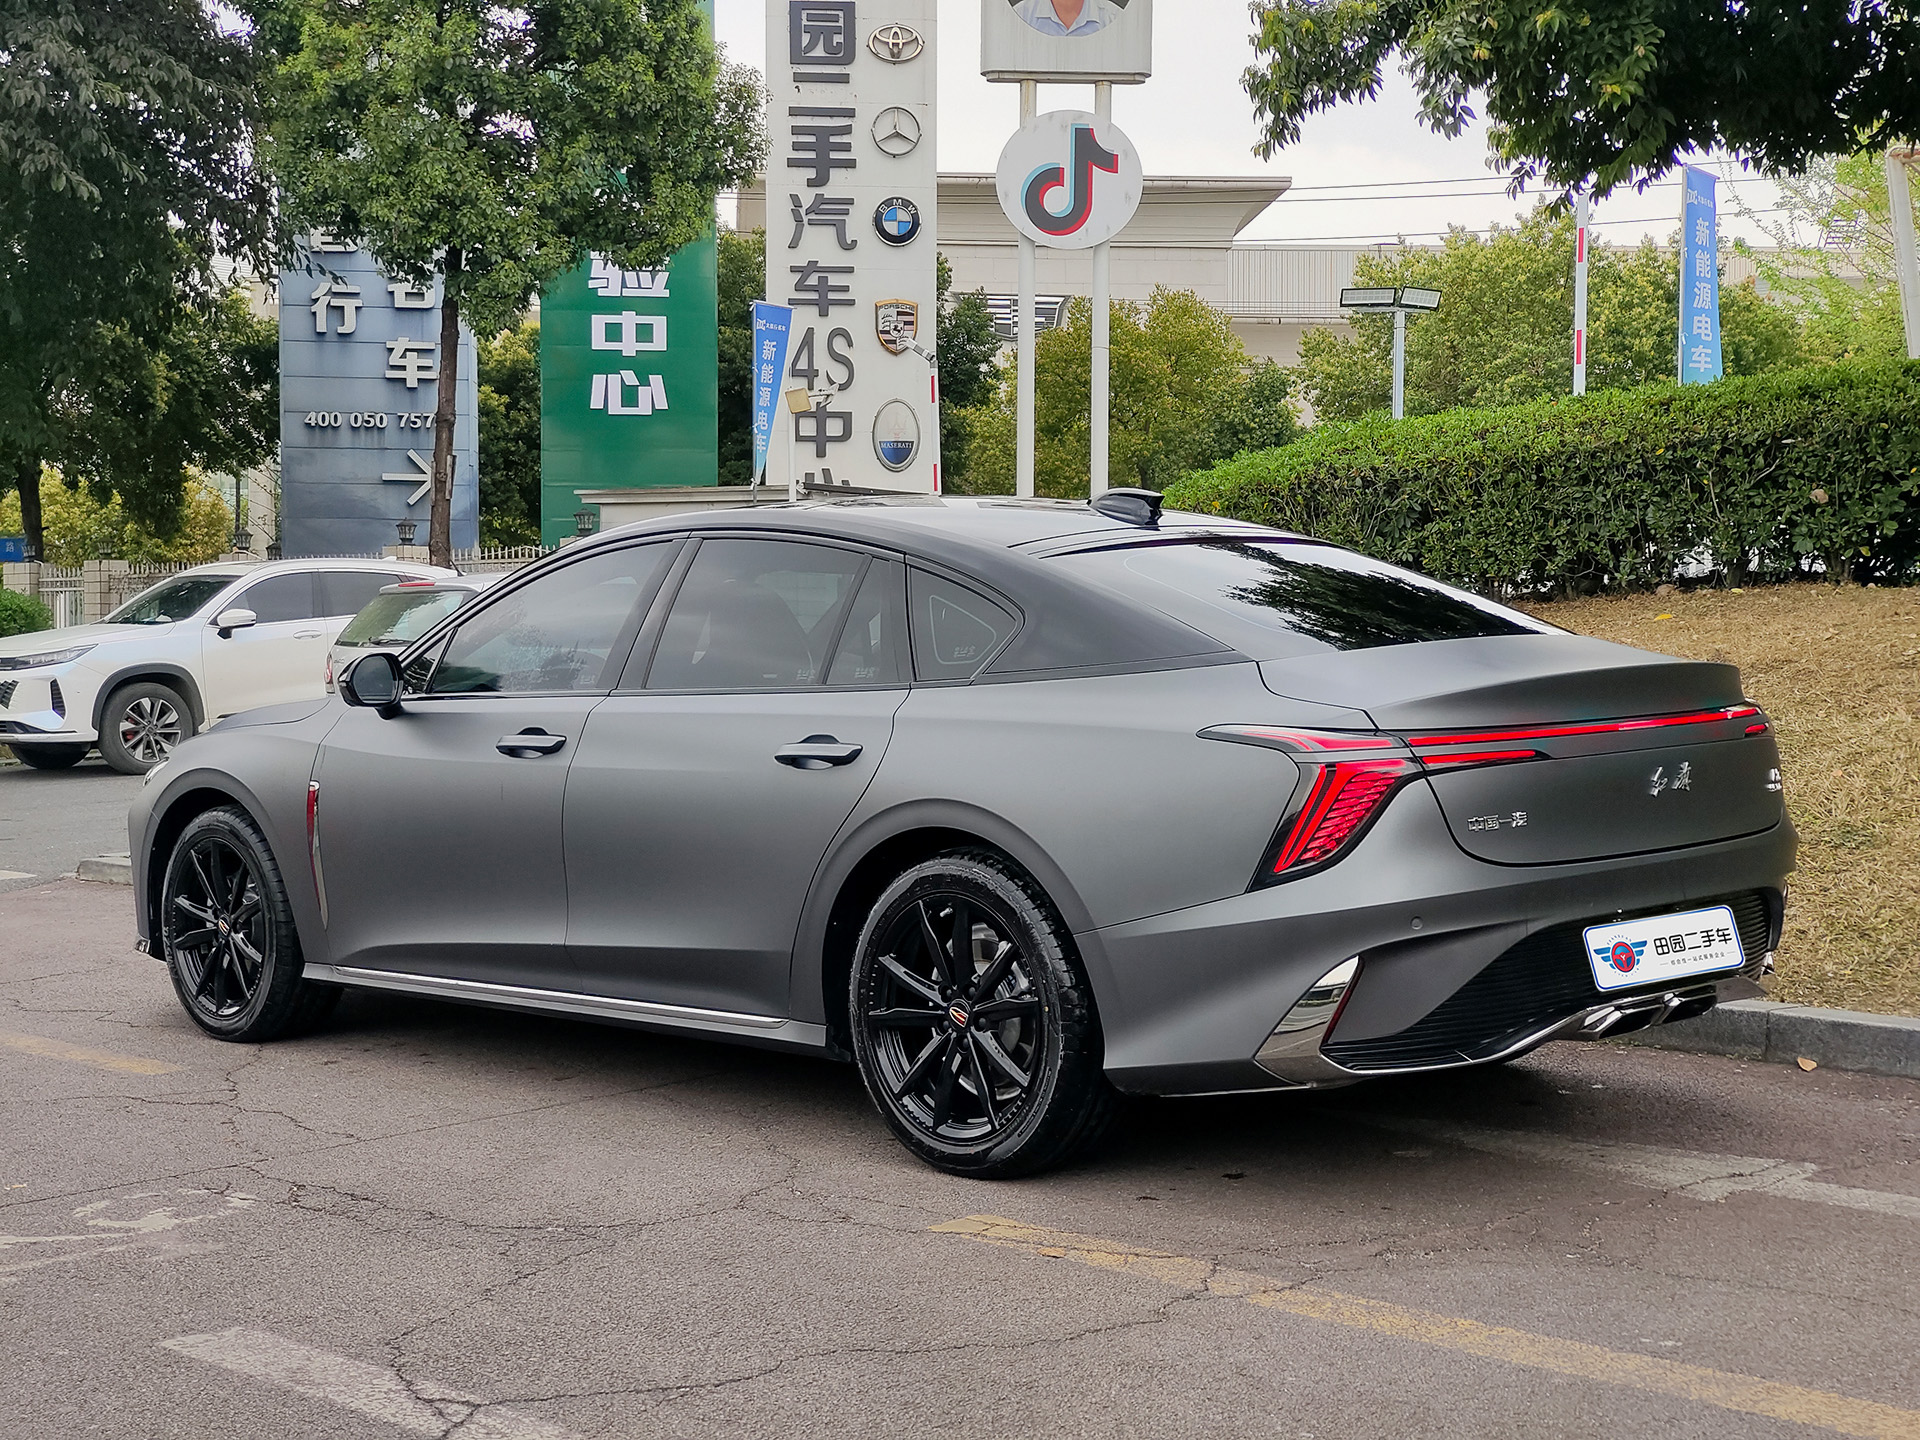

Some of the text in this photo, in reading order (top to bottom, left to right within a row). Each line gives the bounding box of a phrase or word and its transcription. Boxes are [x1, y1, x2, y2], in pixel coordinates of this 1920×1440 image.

[879, 197, 918, 215] BMW
[1688, 217, 1713, 373] 新能源电车
[879, 304, 915, 312] PORSCHE
[588, 250, 670, 415] 验中心
[757, 339, 777, 452] 新能源电车
[304, 411, 437, 429] 400 050 757
[1467, 811, 1528, 832] 中国一汽
[1653, 927, 1733, 956] 田园二手车
